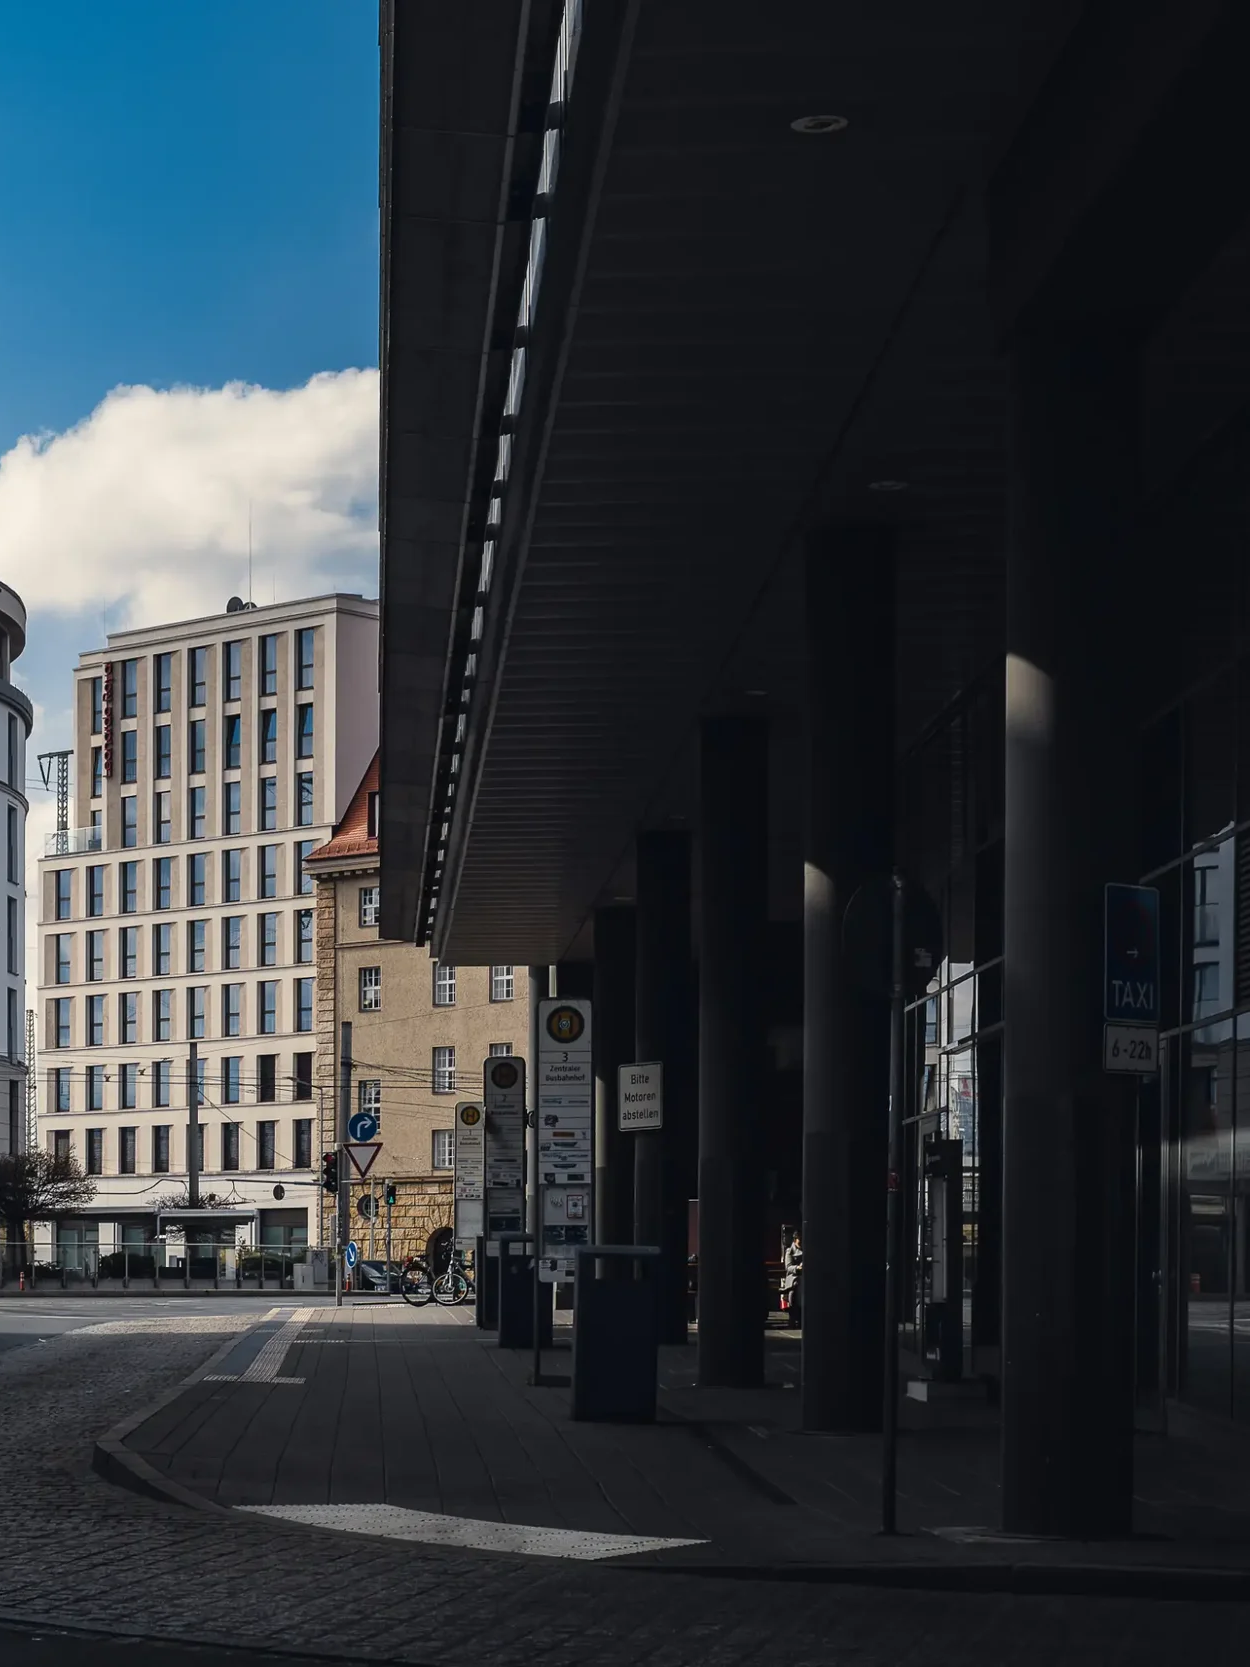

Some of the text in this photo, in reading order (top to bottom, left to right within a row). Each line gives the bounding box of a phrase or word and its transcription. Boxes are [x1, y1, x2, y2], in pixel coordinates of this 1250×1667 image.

[1112, 980, 1154, 1010] TAXI
[561, 1052, 569, 1063] 3
[630, 1074, 650, 1085] Bitte
[624, 1092, 656, 1103] Motoren
[622, 1108, 659, 1121] abstellen
